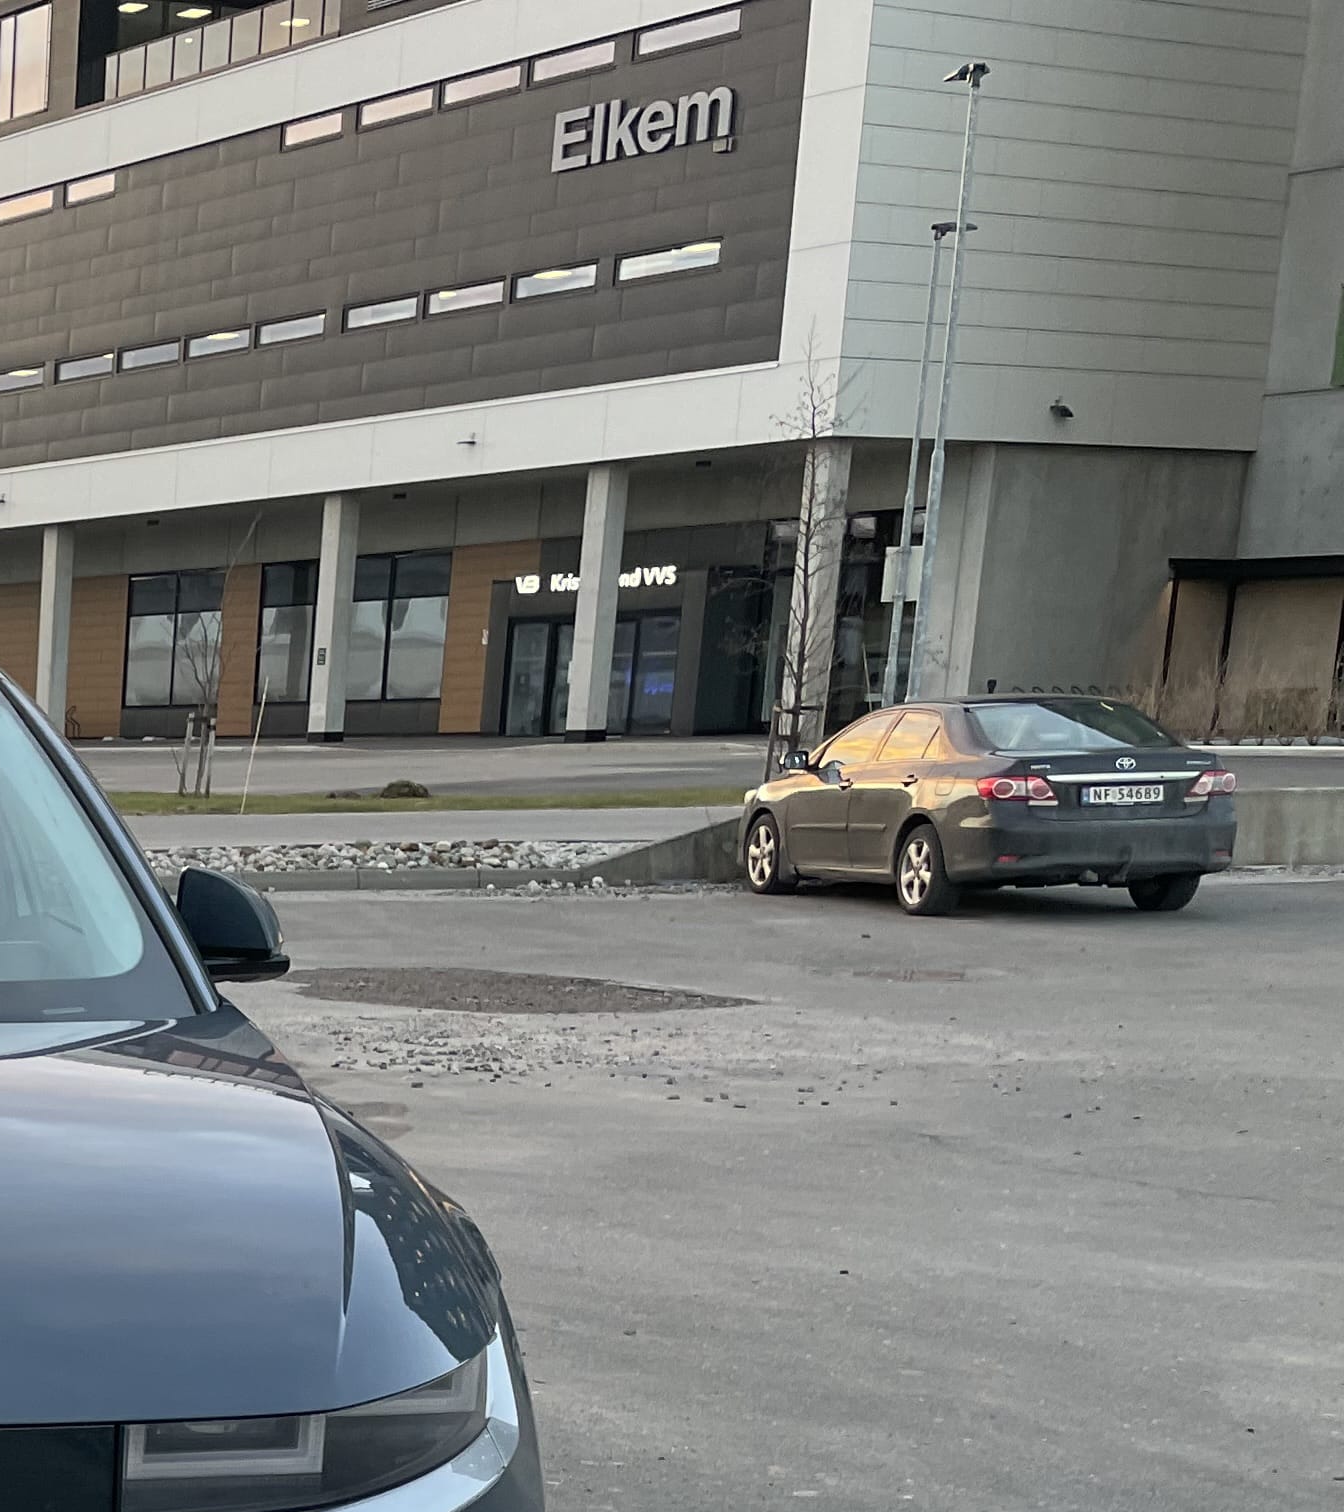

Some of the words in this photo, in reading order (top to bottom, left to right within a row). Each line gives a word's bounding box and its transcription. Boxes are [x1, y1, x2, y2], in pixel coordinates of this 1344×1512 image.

[551, 86, 734, 173] Elkem
[1093, 788, 1111, 801] NF
[1118, 787, 1161, 801] 54689
